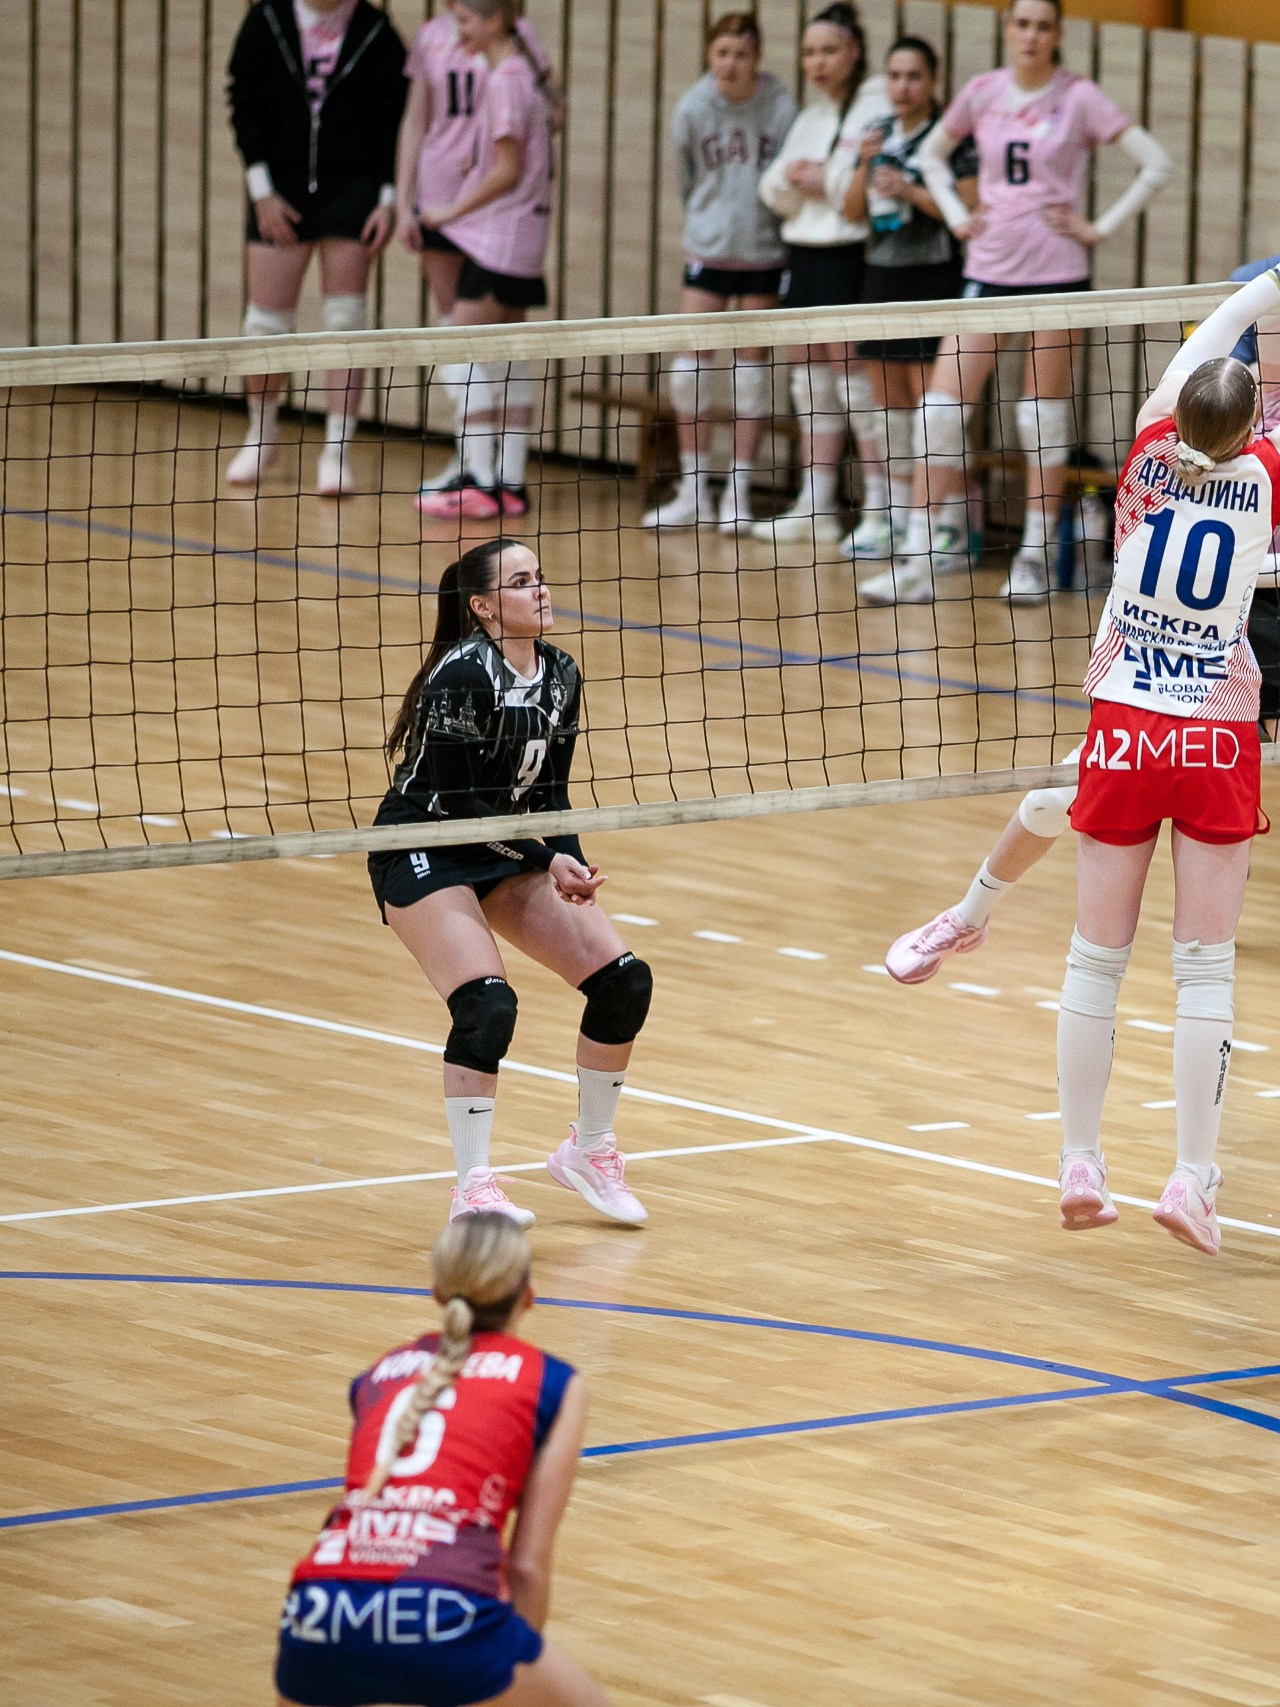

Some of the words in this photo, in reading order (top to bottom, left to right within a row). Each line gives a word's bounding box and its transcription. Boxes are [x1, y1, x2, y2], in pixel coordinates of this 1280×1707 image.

[447, 70, 474, 116] 11
[1005, 142, 1030, 185] 6
[1139, 507, 1236, 610] 10
[1123, 600, 1220, 640] ИСКРА
[510, 739, 547, 801] 9
[1086, 727, 1240, 770] A2MED
